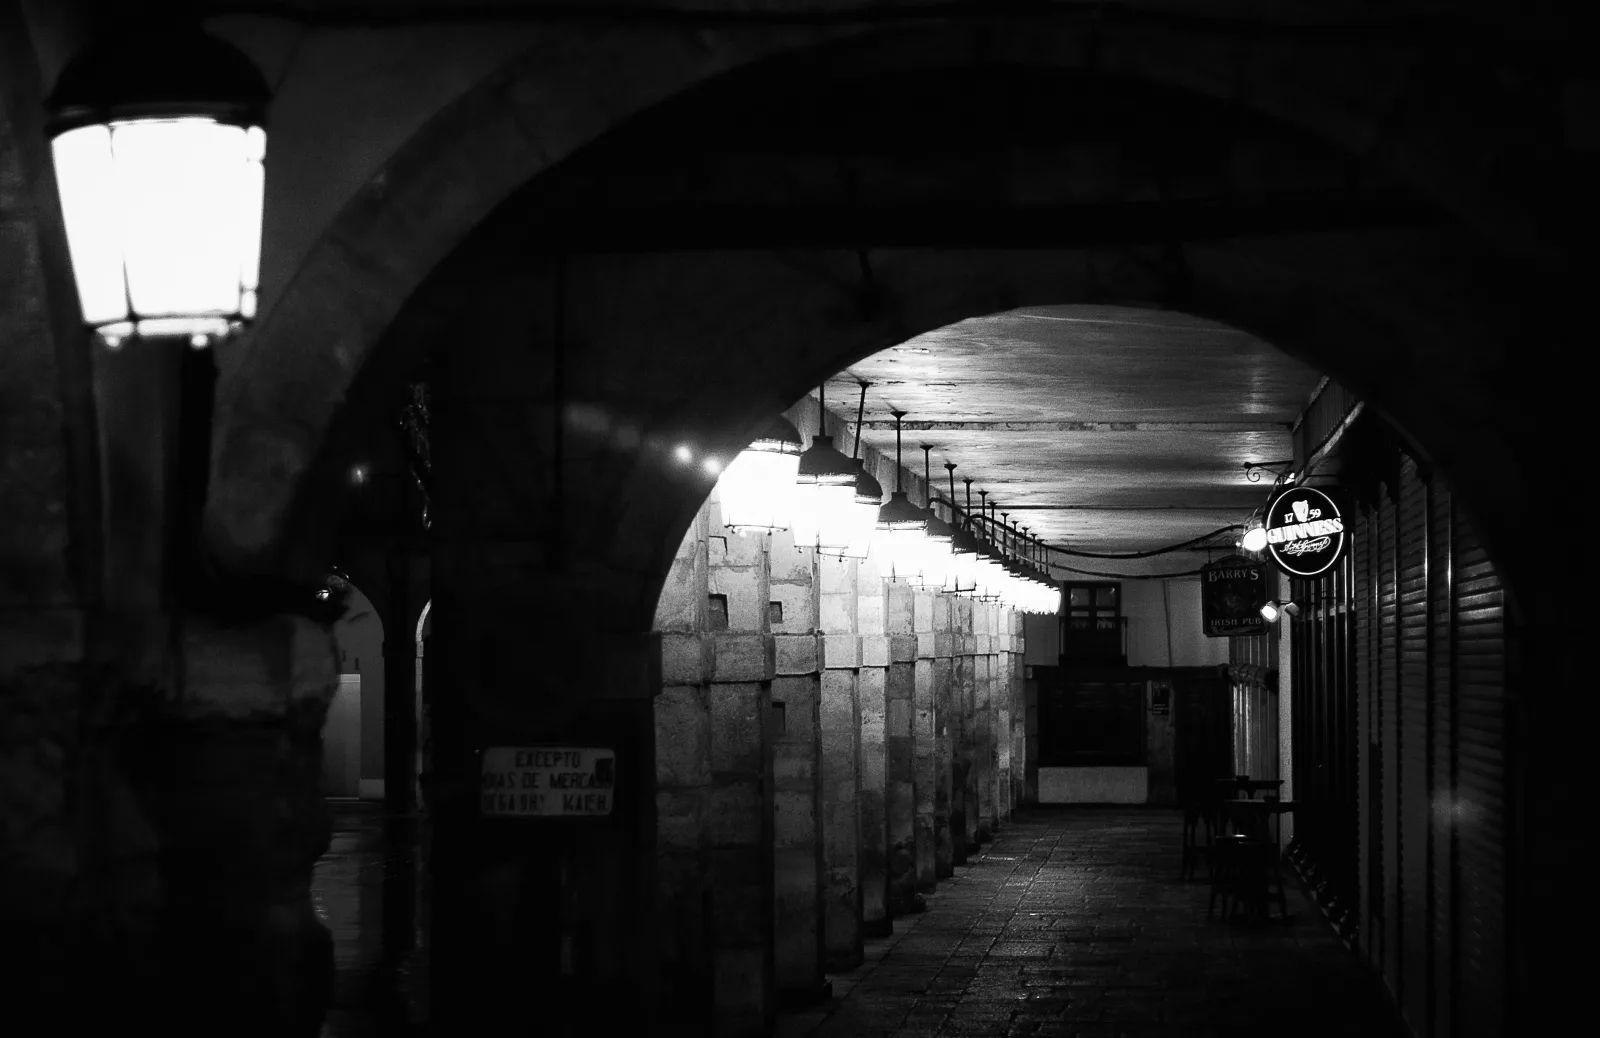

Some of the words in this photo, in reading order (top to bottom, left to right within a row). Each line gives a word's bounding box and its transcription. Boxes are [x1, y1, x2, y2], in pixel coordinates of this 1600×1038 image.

[1267, 518, 1343, 544] GUINNESS
[1210, 618, 1238, 626] IRISH
[1242, 617, 1262, 625] PUB
[515, 750, 581, 768] EXCEPTO
[522, 772, 540, 788] DE
